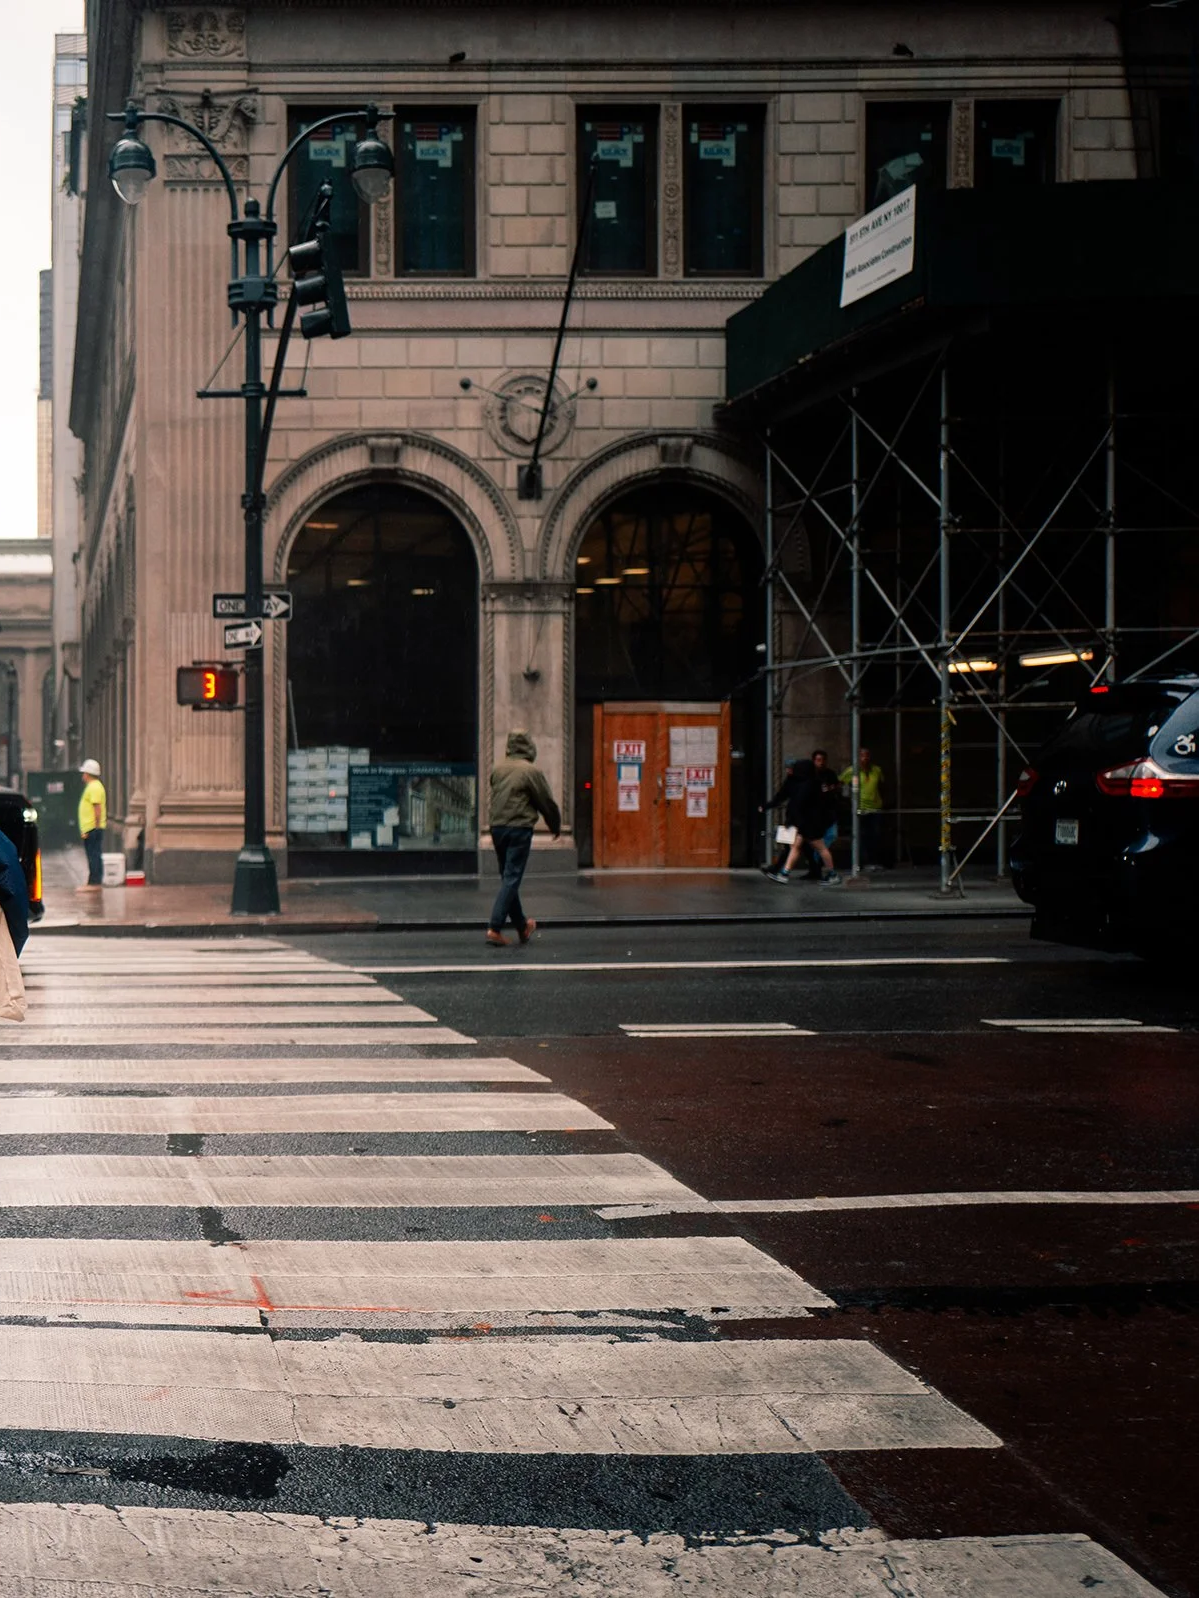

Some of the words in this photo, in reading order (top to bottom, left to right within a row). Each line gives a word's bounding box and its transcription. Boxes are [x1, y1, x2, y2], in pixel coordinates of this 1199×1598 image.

[871, 217, 883, 231] AVE
[884, 211, 892, 222] NY
[881, 236, 913, 260] Construction
[219, 601, 244, 611] ONE
[228, 632, 238, 641] ONE
[203, 672, 216, 699] 3
[617, 744, 641, 754] EXIT
[687, 769, 711, 780] EXIT
